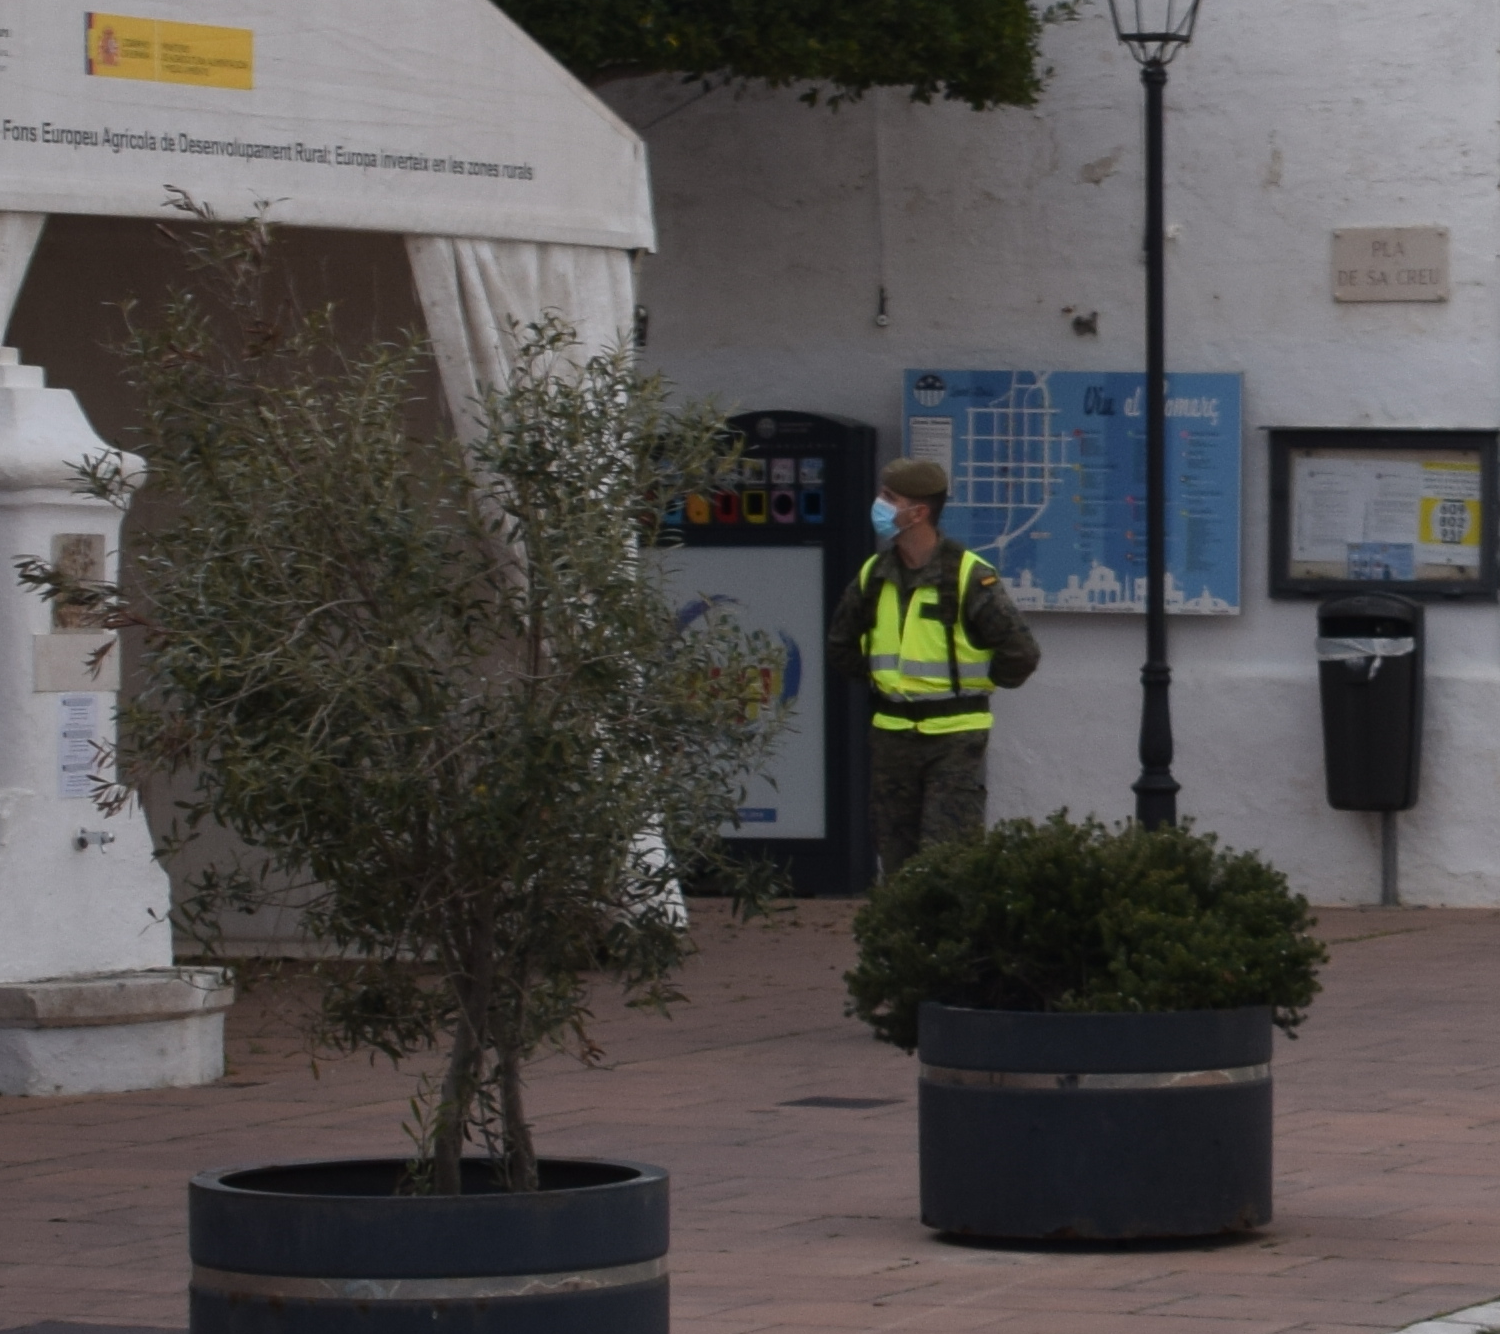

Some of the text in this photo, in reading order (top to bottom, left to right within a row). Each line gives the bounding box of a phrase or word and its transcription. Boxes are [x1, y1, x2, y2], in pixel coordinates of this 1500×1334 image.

[2, 119, 37, 143] Fons
[42, 122, 98, 151] Europeu
[102, 128, 157, 153] Agrícola
[160, 132, 176, 153] de
[179, 133, 292, 162] Desenvolupament
[336, 146, 377, 171] Europa
[381, 149, 430, 173] inverteix
[432, 158, 446, 173] en
[449, 154, 464, 174] les
[467, 160, 500, 178] zones
[503, 162, 533, 181] rurals
[1371, 240, 1405, 258] PLA
[1337, 268, 1440, 286] DE SA CREU
[1439, 516, 1466, 529] 802
